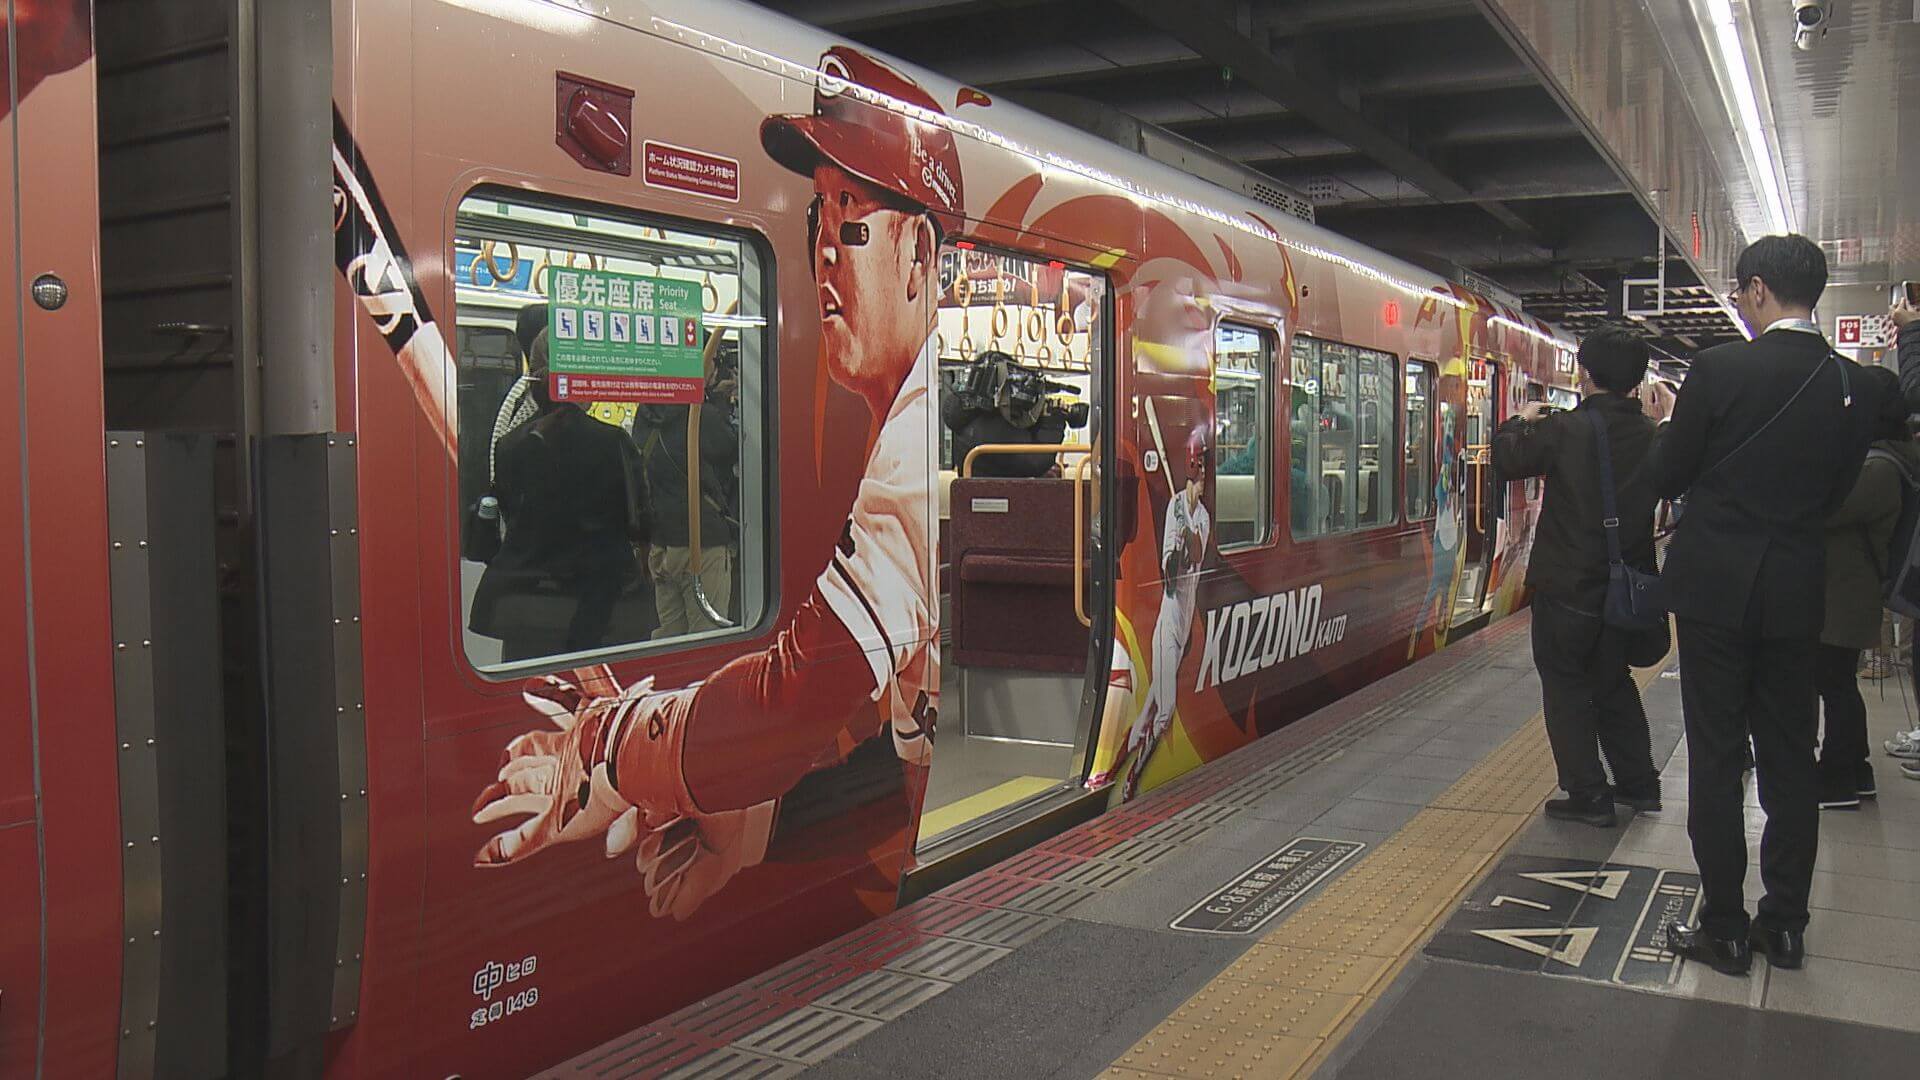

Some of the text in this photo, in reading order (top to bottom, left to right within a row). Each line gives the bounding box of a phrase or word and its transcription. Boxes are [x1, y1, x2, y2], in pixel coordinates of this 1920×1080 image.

[554, 270, 656, 312] 優先座席
[659, 285, 689, 300] Priority
[659, 299, 678, 311] Seat
[1840, 321, 1860, 329] SOS
[1194, 583, 1347, 693] KOZONO KAITO
